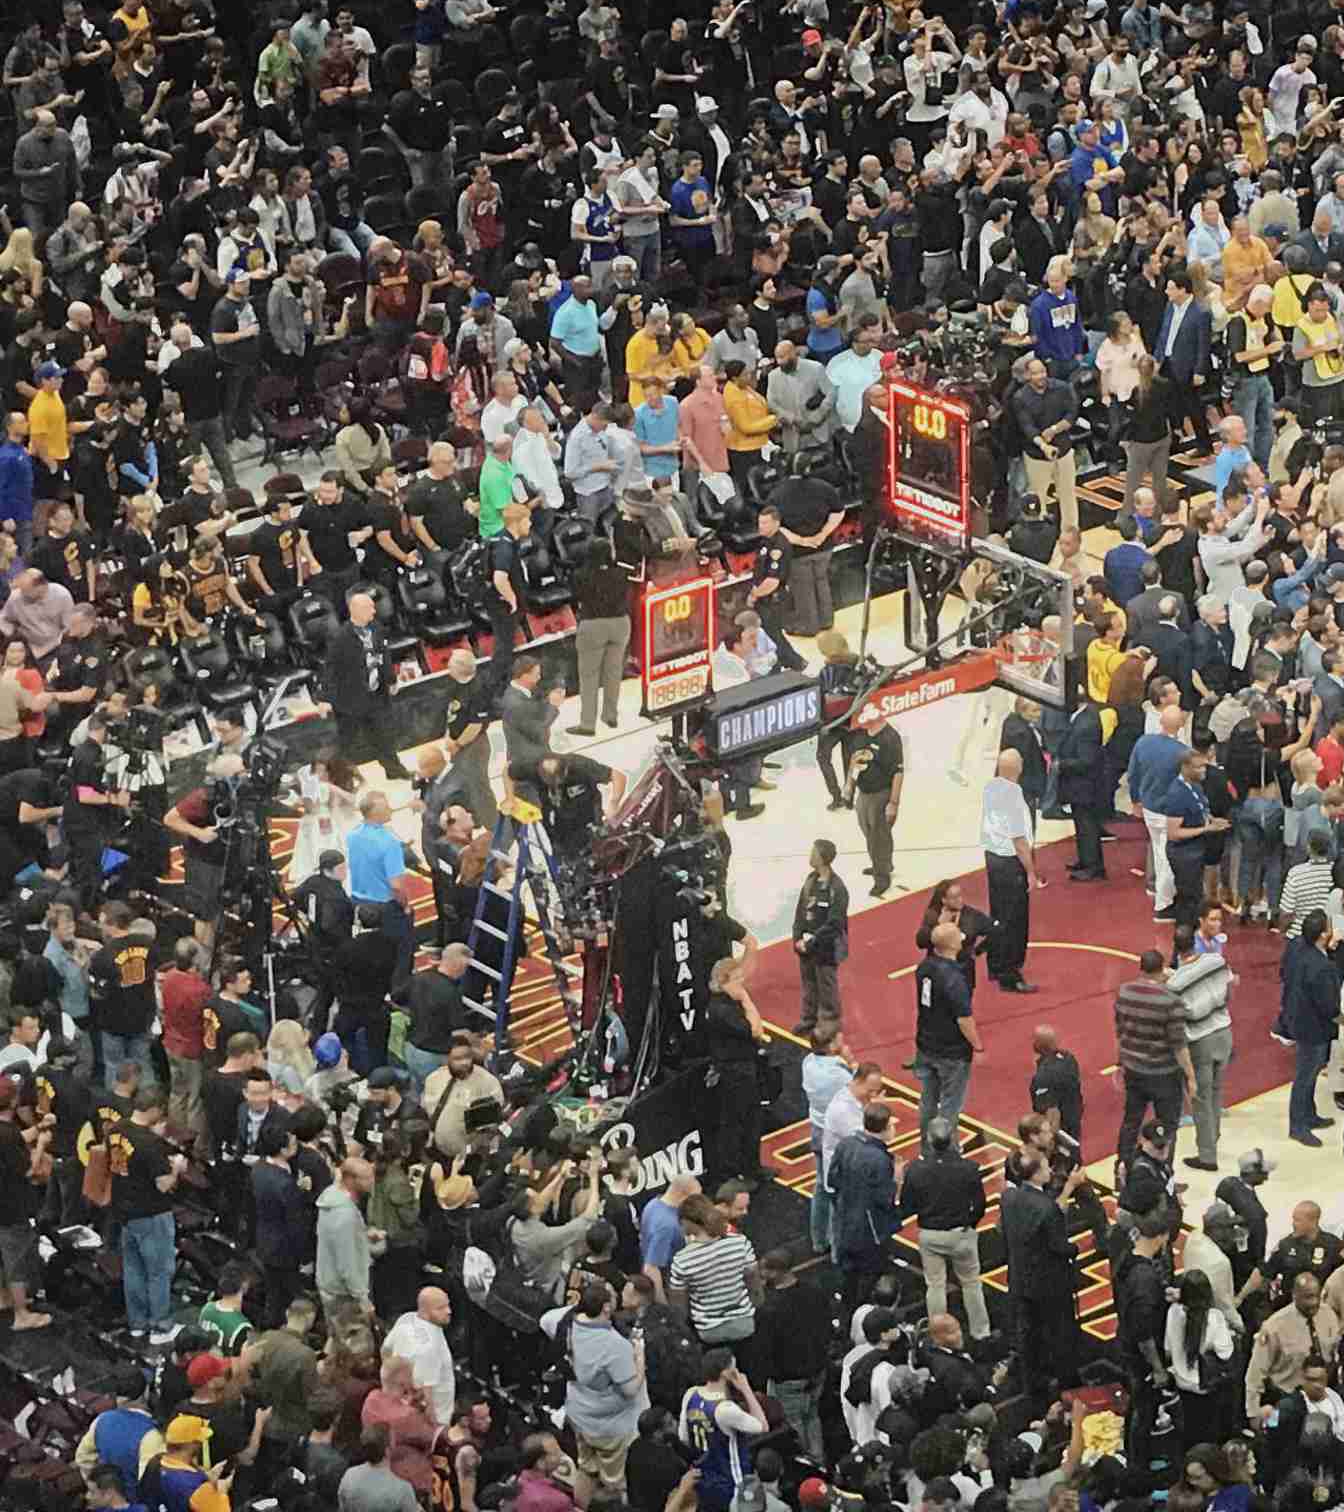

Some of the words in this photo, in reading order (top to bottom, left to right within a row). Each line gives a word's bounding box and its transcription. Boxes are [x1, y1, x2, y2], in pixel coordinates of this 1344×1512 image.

[720, 690, 817, 749] CHAMPIONS
[672, 918, 693, 984] NBA
[679, 988, 695, 1031] TV
